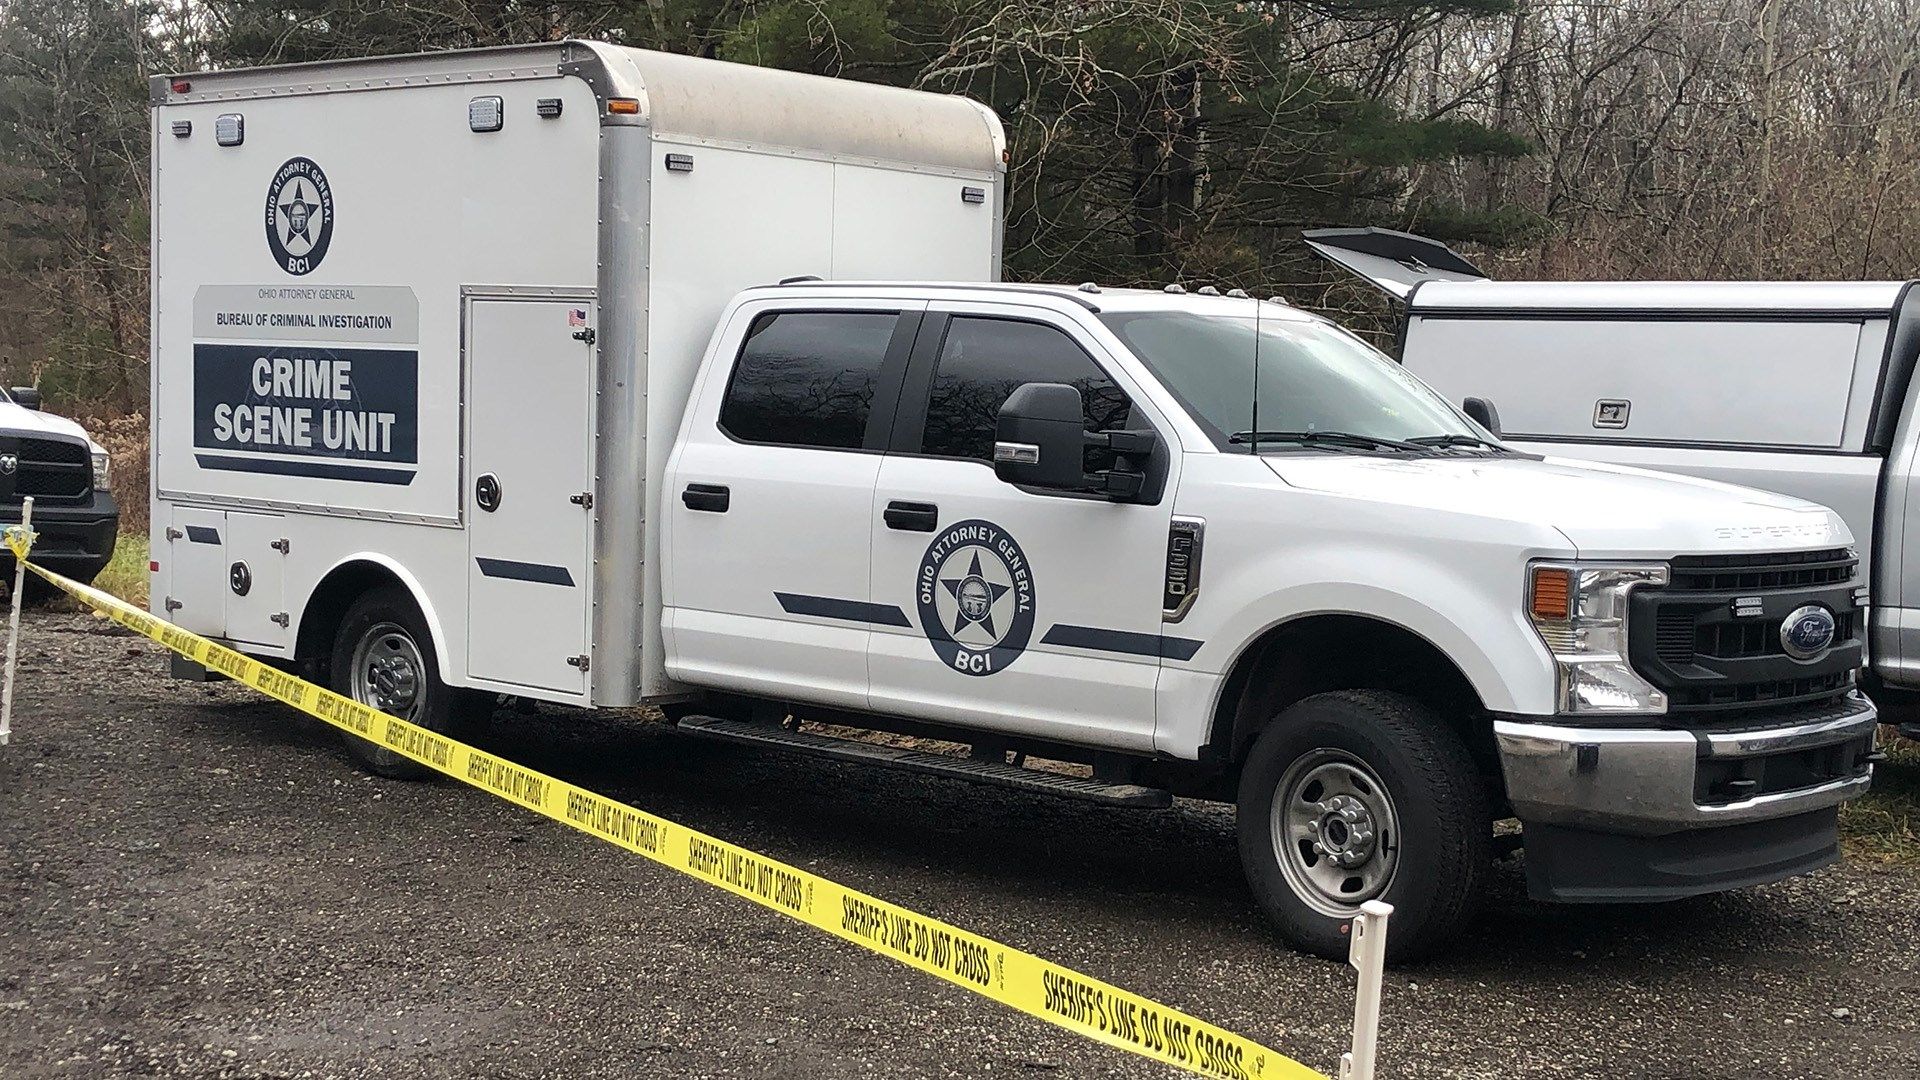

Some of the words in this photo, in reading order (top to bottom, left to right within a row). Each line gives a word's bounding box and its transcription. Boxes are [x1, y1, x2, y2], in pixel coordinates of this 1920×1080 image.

[267, 195, 277, 226] OHIO
[273, 161, 311, 194] ATTORNEY
[311, 168, 331, 224] GENERAL
[287, 257, 311, 273] BCI
[258, 288, 277, 299] OHIO
[278, 288, 317, 300] ATTORNEY
[318, 289, 355, 300] GENERAL
[216, 312, 253, 326] BUREAU
[255, 313, 268, 327] OF
[270, 314, 316, 328] CRIMINAL
[318, 315, 392, 329] INVESTIGATION
[252, 357, 351, 400] CRIME
[213, 403, 312, 447] SCENE
[322, 409, 396, 453] UNIT
[921, 565, 935, 604] OHIO
[931, 526, 997, 564] ATTORNEY
[998, 538, 1030, 614] GENERAL
[954, 649, 991, 673] BCI
[596, 802, 611, 834] LINE
[611, 808, 621, 838] DO
[622, 811, 635, 844] NOT
[636, 817, 658, 853] CROSS
[726, 850, 743, 887] LINE
[744, 858, 756, 893] DO
[757, 862, 773, 900] NOT
[775, 869, 802, 912] CROSS
[842, 894, 888, 945] SHERIFF'S
[890, 912, 913, 955] LINE
[914, 921, 929, 962] DO
[931, 928, 950, 970] NOT
[954, 936, 990, 987] CROSS
[1043, 969, 1107, 1031] SHERIFF'S
[1108, 994, 1140, 1044] LINE
[1140, 1008, 1163, 1052] DO
[1163, 1016, 1194, 1065] NOT
[1195, 1029, 1249, 1080] CROSS
